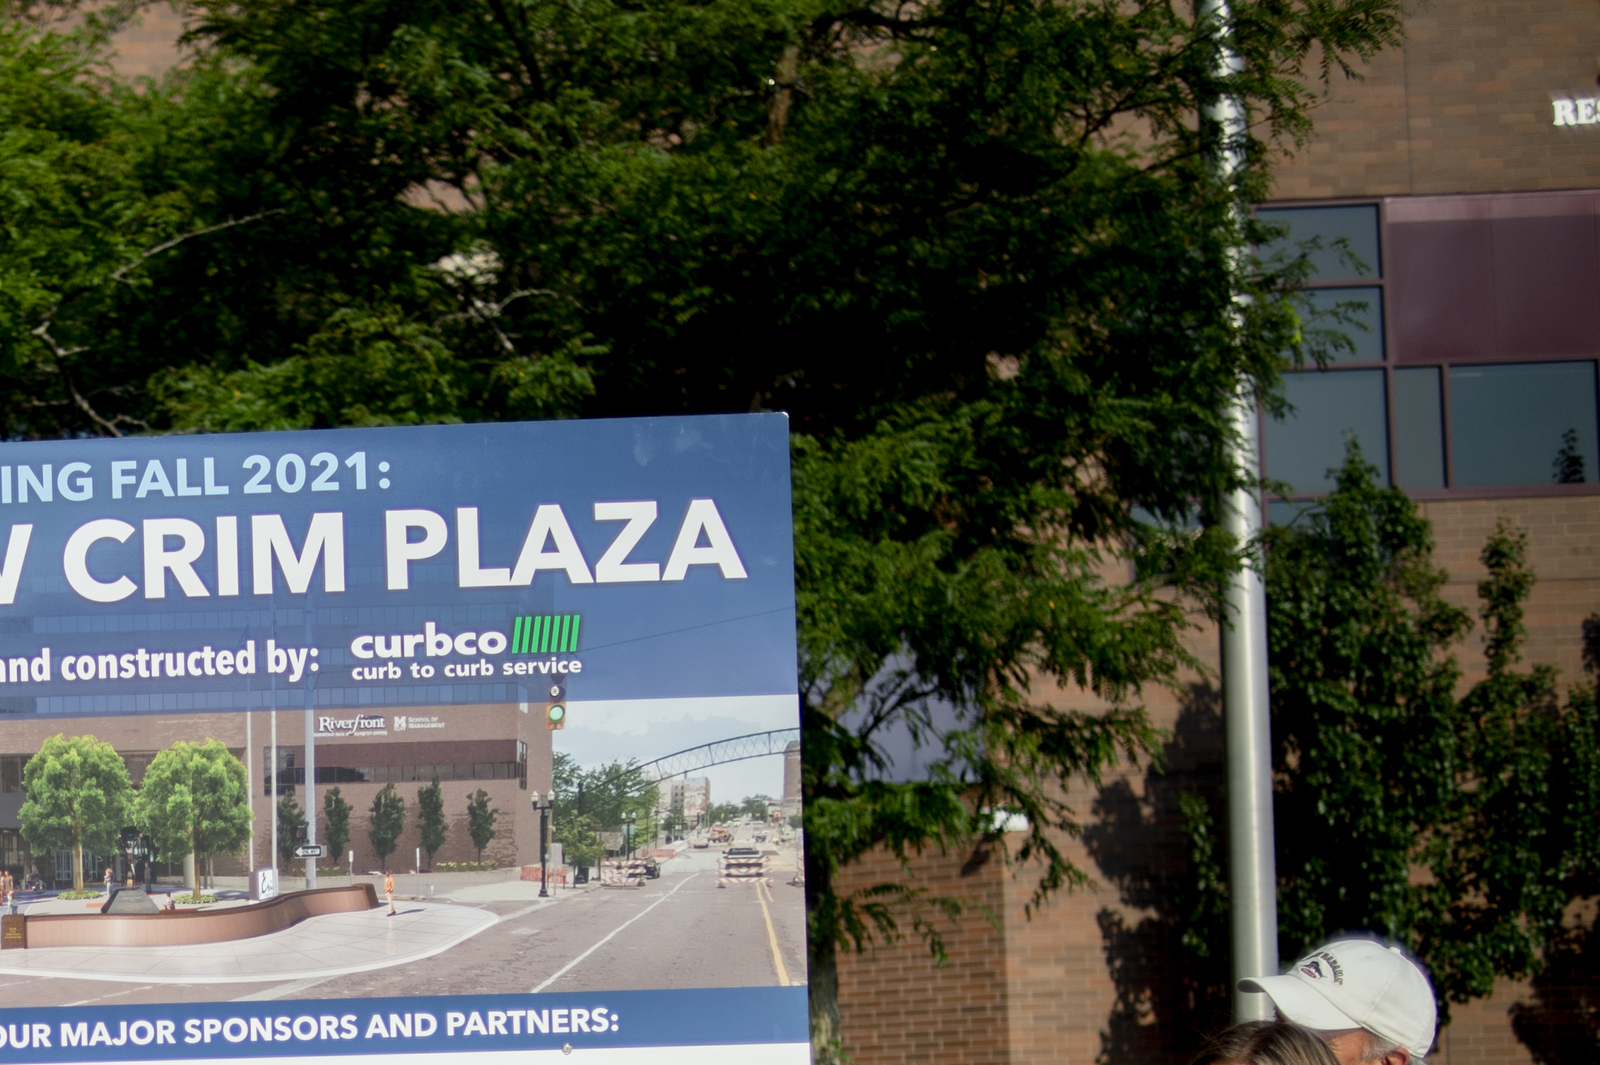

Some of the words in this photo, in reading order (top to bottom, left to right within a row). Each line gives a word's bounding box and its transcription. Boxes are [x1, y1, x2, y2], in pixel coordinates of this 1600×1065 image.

[1552, 99, 1600, 126] RE
[112, 458, 229, 499] FALL
[243, 452, 390, 493] 2021:
[64, 512, 345, 602] CRIM
[386, 500, 747, 589] PLAZA
[351, 622, 506, 658] curbco
[61, 640, 255, 680] constructed
[267, 640, 318, 682] by:
[352, 662, 401, 680] curb
[410, 663, 434, 678] to
[445, 659, 493, 677] curb
[503, 657, 581, 675] service
[61, 1020, 176, 1046] MAJOR
[185, 1015, 357, 1043] SPONSORS
[365, 1013, 437, 1038] AND
[447, 1008, 618, 1036] PARTNERS:
